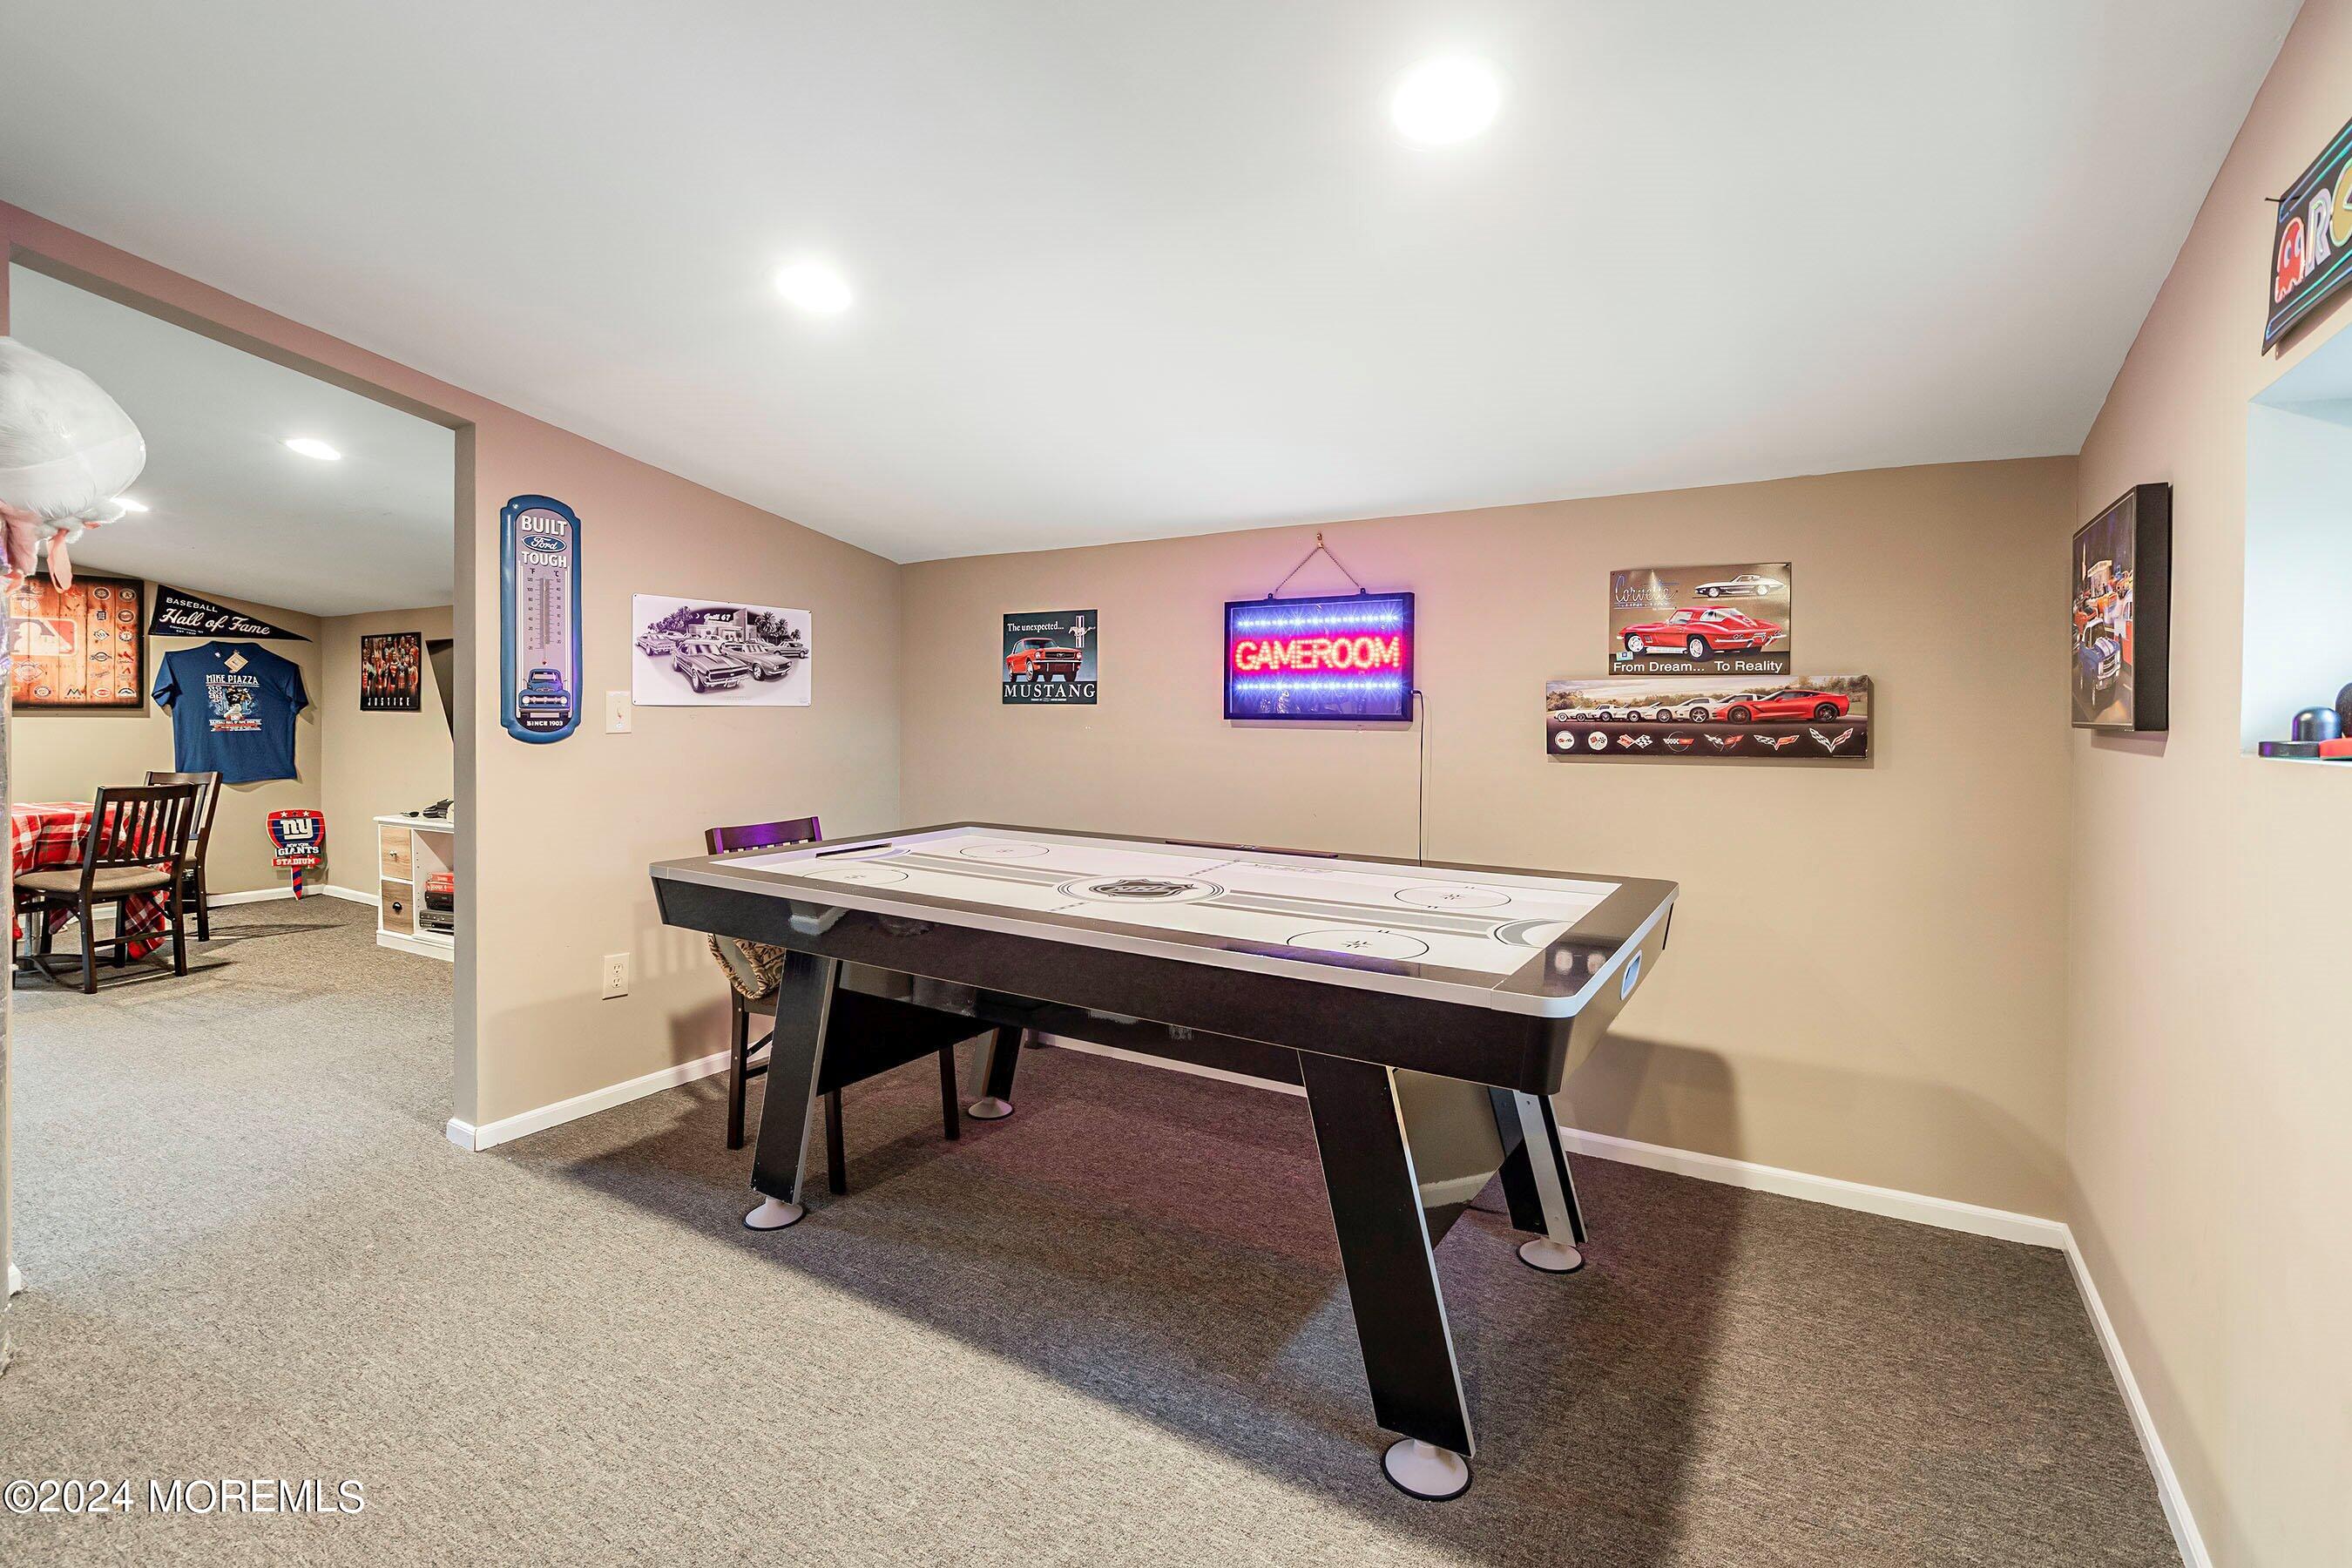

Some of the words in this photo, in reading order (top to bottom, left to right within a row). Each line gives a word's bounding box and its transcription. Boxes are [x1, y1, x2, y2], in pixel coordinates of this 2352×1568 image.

[522, 515, 567, 536] BUILT
[531, 537, 558, 550] Ford
[522, 551, 567, 568] TOUGH
[1615, 575, 1677, 603] Corvette
[166, 597, 218, 612] BASEBALL
[159, 608, 204, 626] Hall
[205, 616, 228, 632] of
[228, 617, 271, 635] Fame
[1007, 623, 1020, 632] The
[1022, 621, 1064, 633] unexpected...
[1234, 635, 1401, 672] GAMEROOM
[1613, 662, 1645, 672] From
[1649, 661, 1705, 672] Dream...
[1714, 660, 1730, 672] To
[1735, 660, 1783, 673] Reality
[206, 673, 226, 684] MIKE
[227, 674, 259, 685] PIAZZA
[1004, 683, 1096, 698] MUSTANG
[368, 697, 410, 706] JUSTICE
[278, 846, 320, 856] GIANTS
